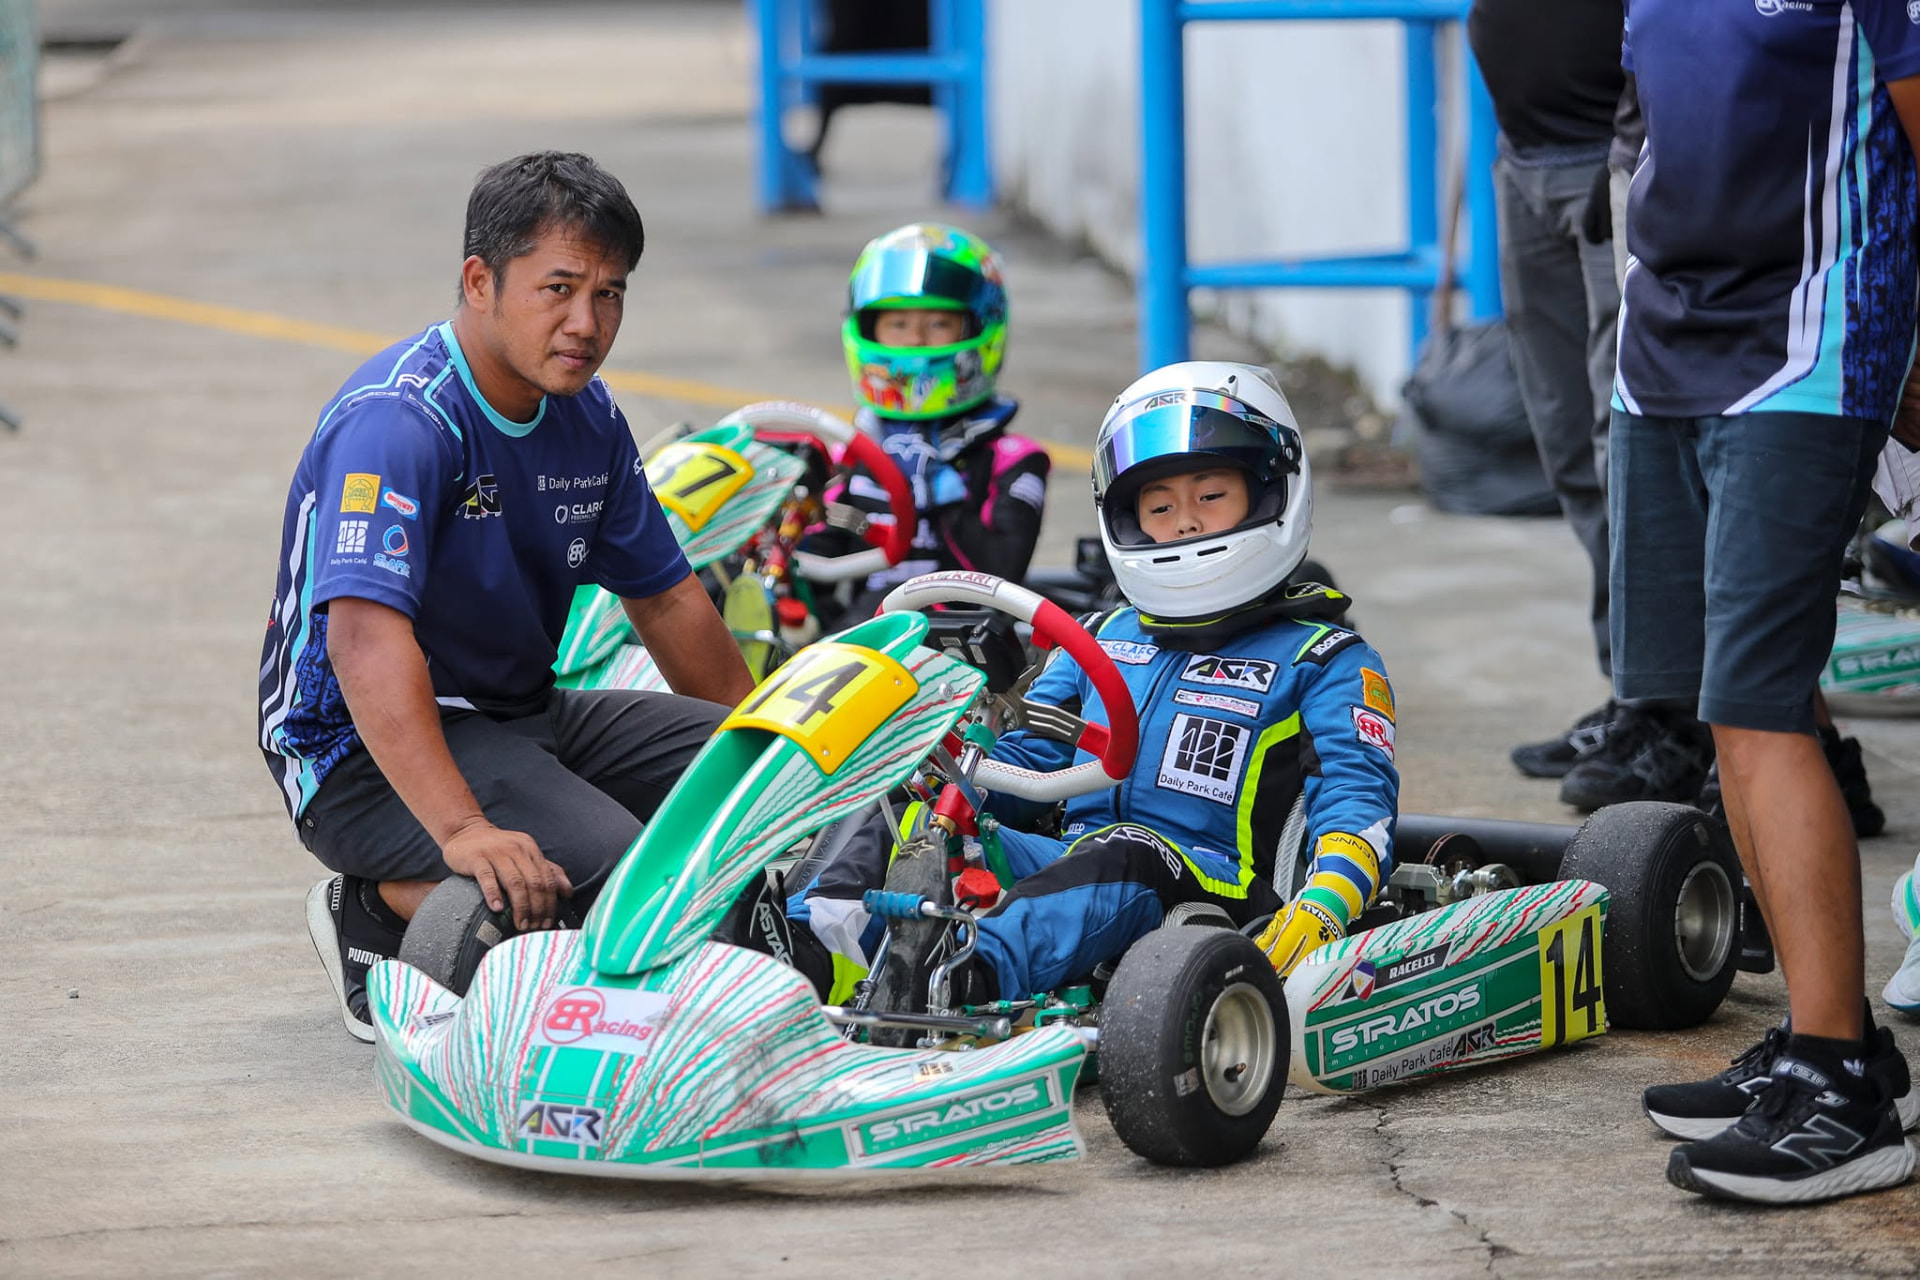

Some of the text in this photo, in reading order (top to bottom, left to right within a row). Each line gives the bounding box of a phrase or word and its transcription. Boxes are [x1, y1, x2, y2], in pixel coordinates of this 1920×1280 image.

[549, 472, 608, 491] Daily Park Café
[742, 652, 868, 726] 14
[1187, 658, 1272, 685] AGR
[1160, 774, 1233, 802] Daily Park Café
[757, 902, 794, 968] ASTAR
[1304, 903, 1343, 940] ACIONAL
[1389, 953, 1436, 979] RACELIS
[1546, 915, 1602, 1046] 14
[1332, 983, 1480, 1054] STRATOS
[1372, 1042, 1452, 1084] Daily Park Café
[869, 1083, 1039, 1142] STRATOS
